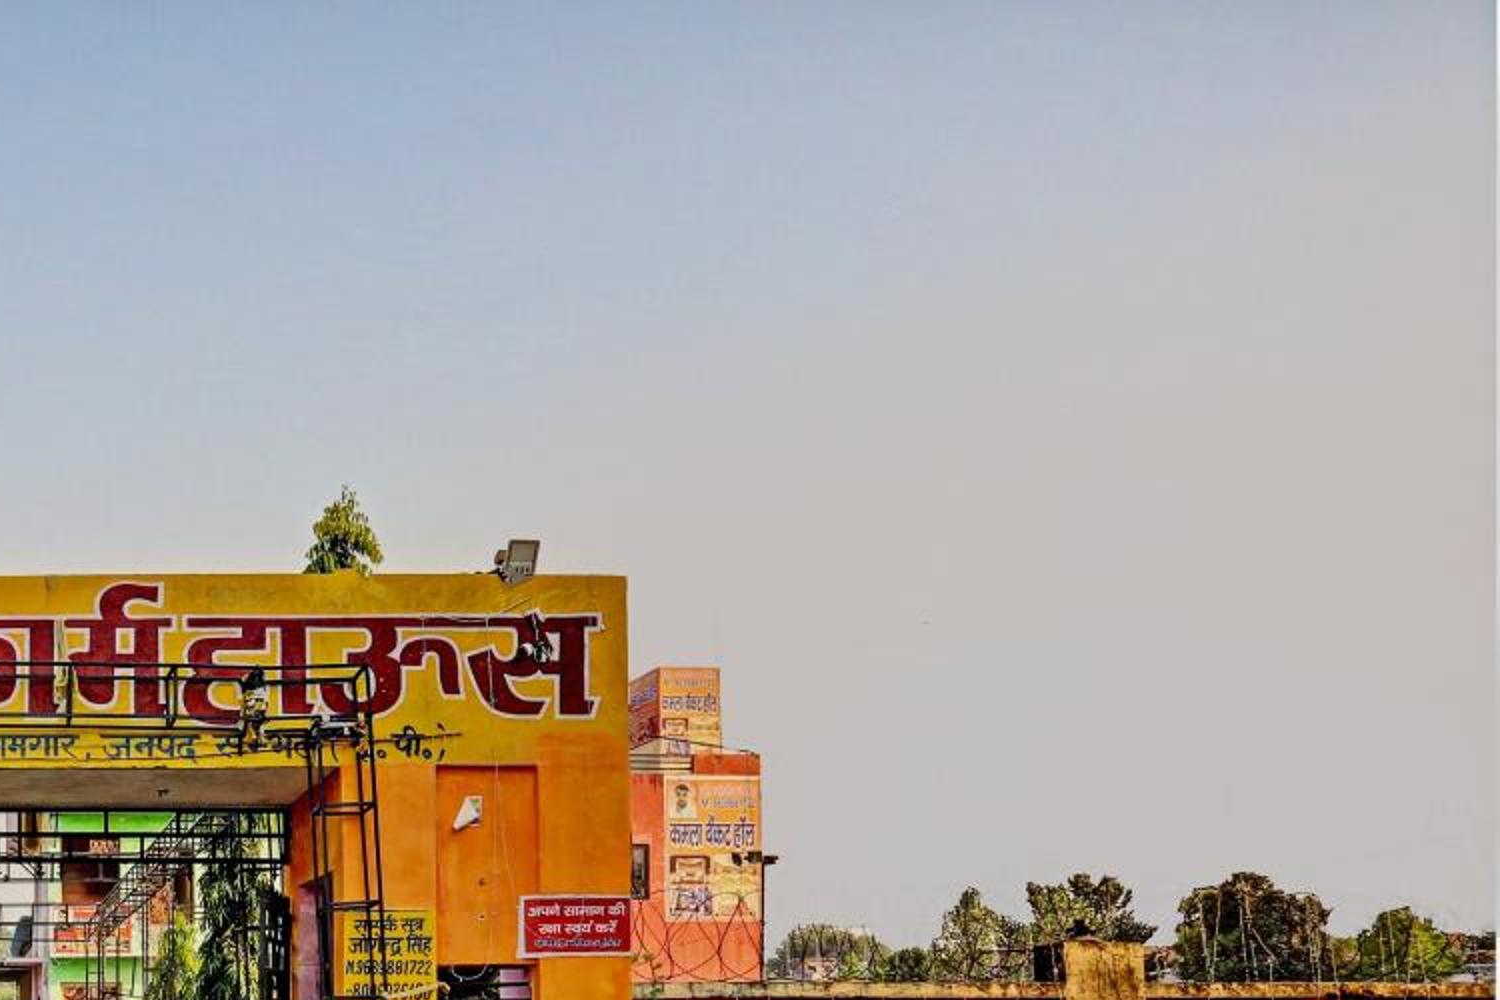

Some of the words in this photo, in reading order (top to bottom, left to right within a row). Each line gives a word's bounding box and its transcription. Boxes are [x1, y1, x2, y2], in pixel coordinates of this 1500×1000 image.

[100, 734, 200, 764] जनपद
[527, 902, 561, 917] अपने
[563, 905, 604, 917] सामान
[607, 901, 626, 916] की
[564, 919, 594, 935] स्वयं
[595, 919, 618, 934] करें
